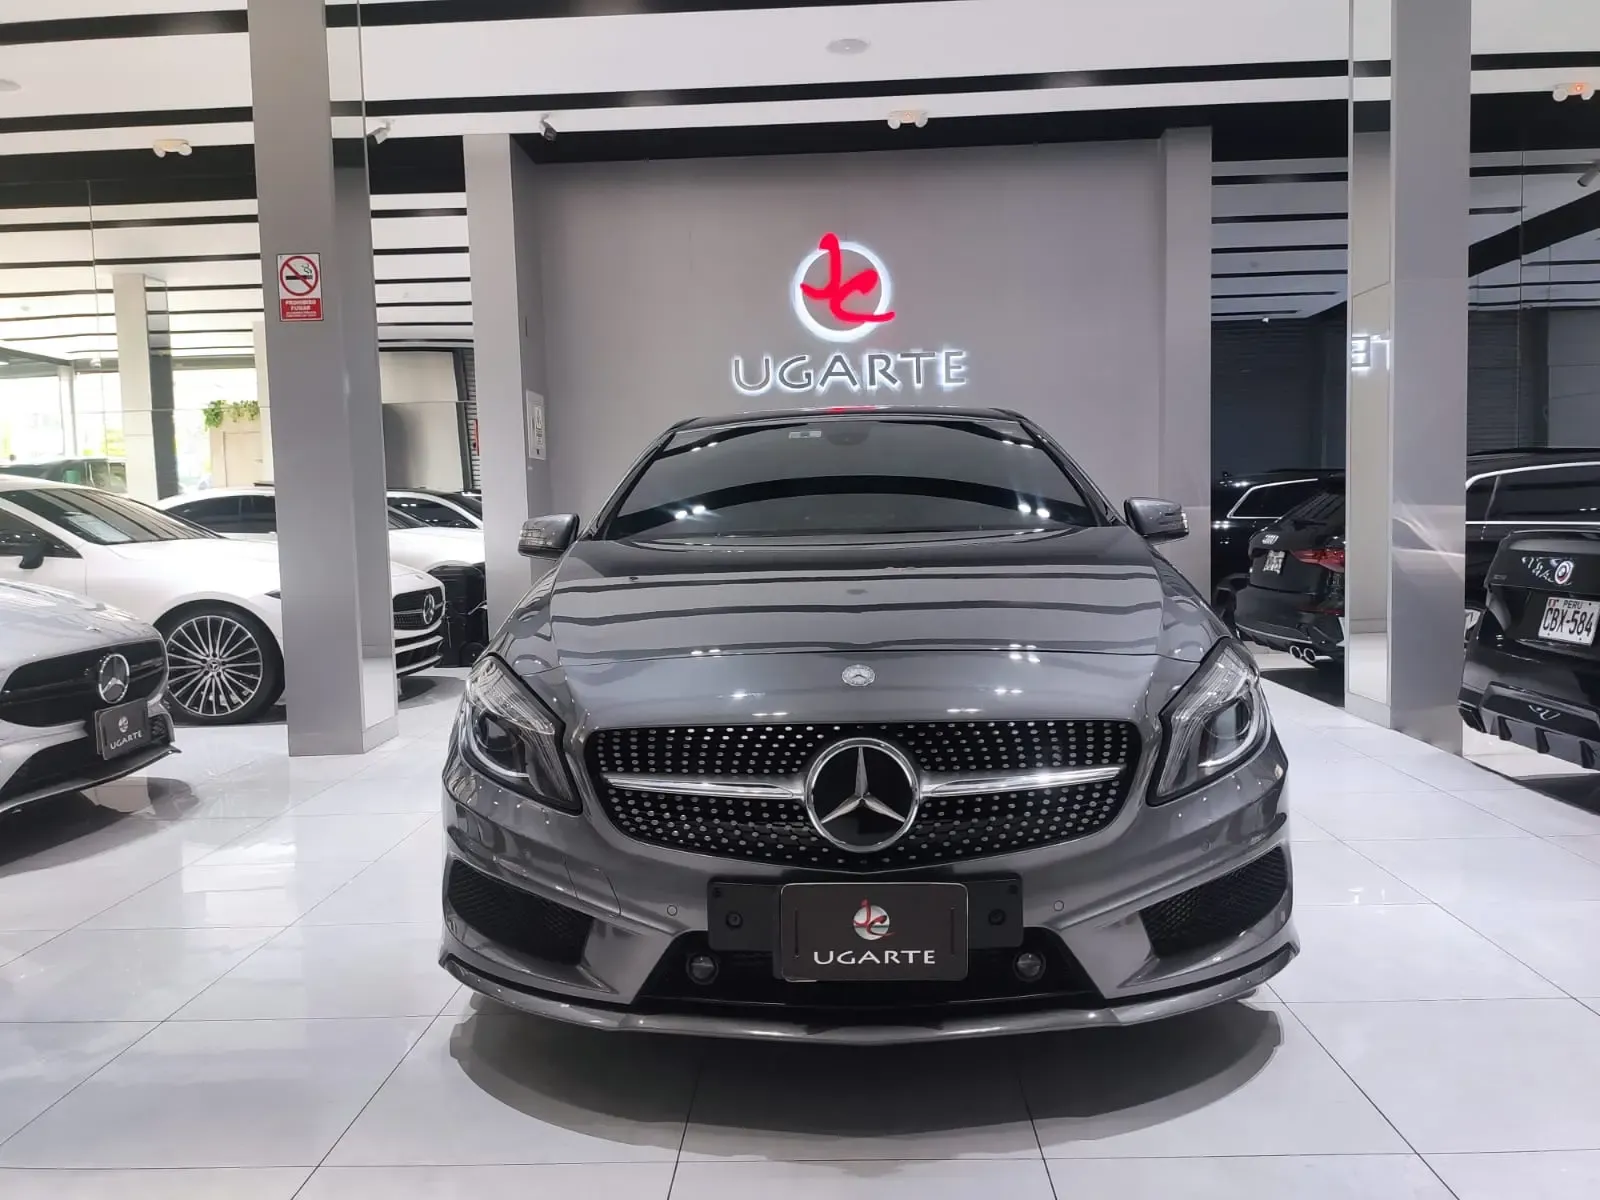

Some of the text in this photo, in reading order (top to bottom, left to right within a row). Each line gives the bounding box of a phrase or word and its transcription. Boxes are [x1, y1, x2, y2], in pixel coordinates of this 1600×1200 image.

[732, 349, 967, 393] UGARTE
[1563, 600, 1583, 609] PERU
[1542, 607, 1595, 637] CBX-584
[110, 730, 142, 750] UGARTE
[813, 950, 936, 965] UGARTE
